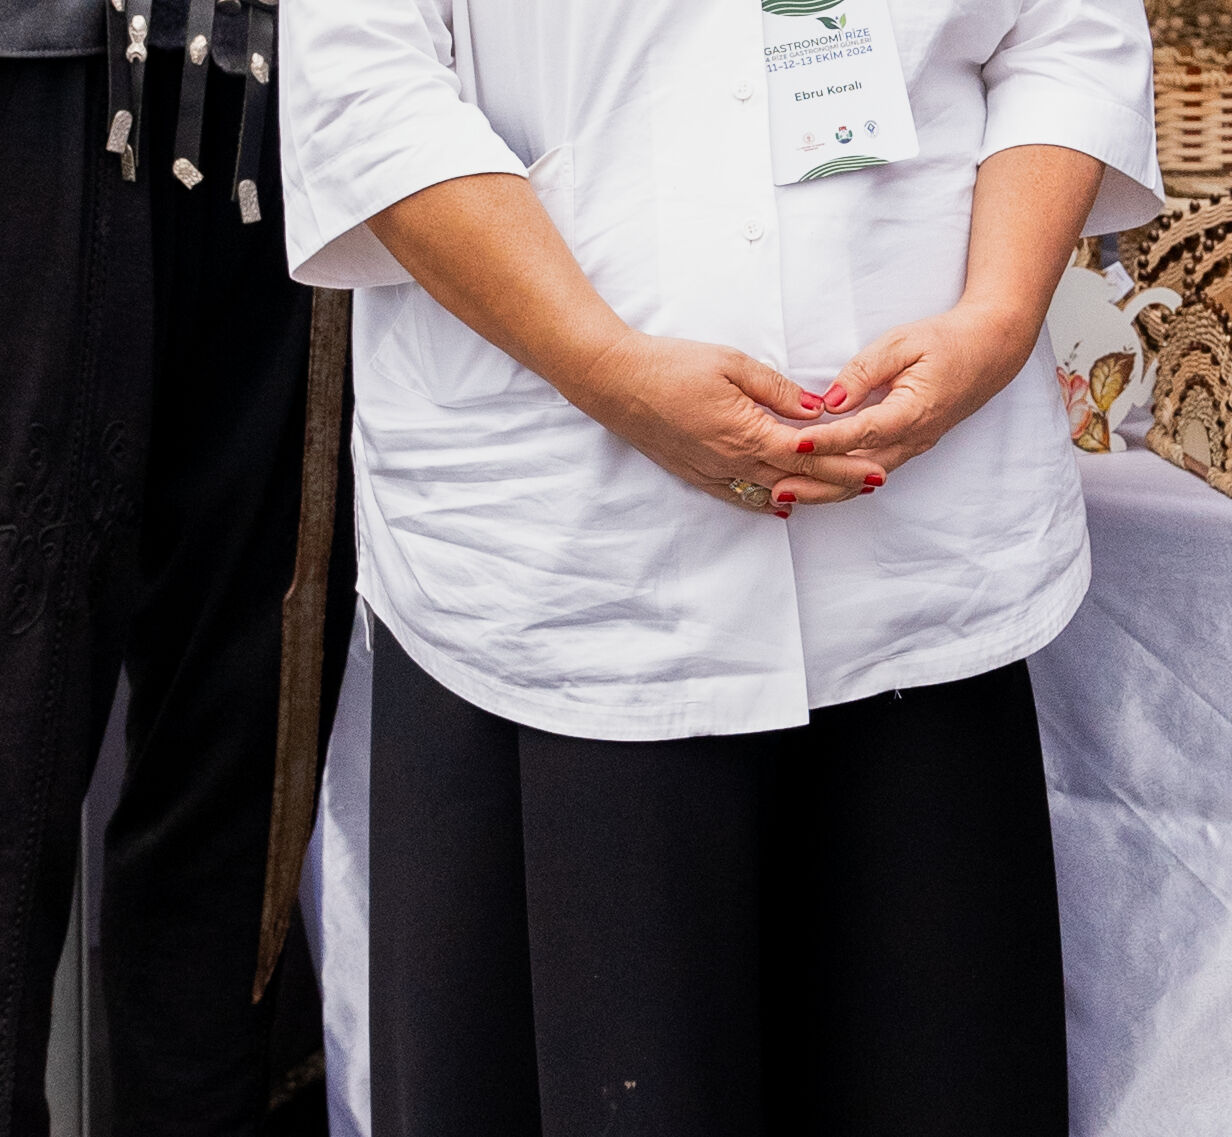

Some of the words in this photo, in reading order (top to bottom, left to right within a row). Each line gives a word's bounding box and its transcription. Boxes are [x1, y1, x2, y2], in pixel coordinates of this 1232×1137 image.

[763, 31, 842, 56] GASTRONOMİ
[845, 27, 871, 40] RİZE
[767, 56, 813, 73] 11-12-13
[815, 50, 843, 63] EKİM
[846, 44, 873, 57] 2024
[794, 89, 824, 102] Ebru
[826, 80, 862, 95] Koralı
